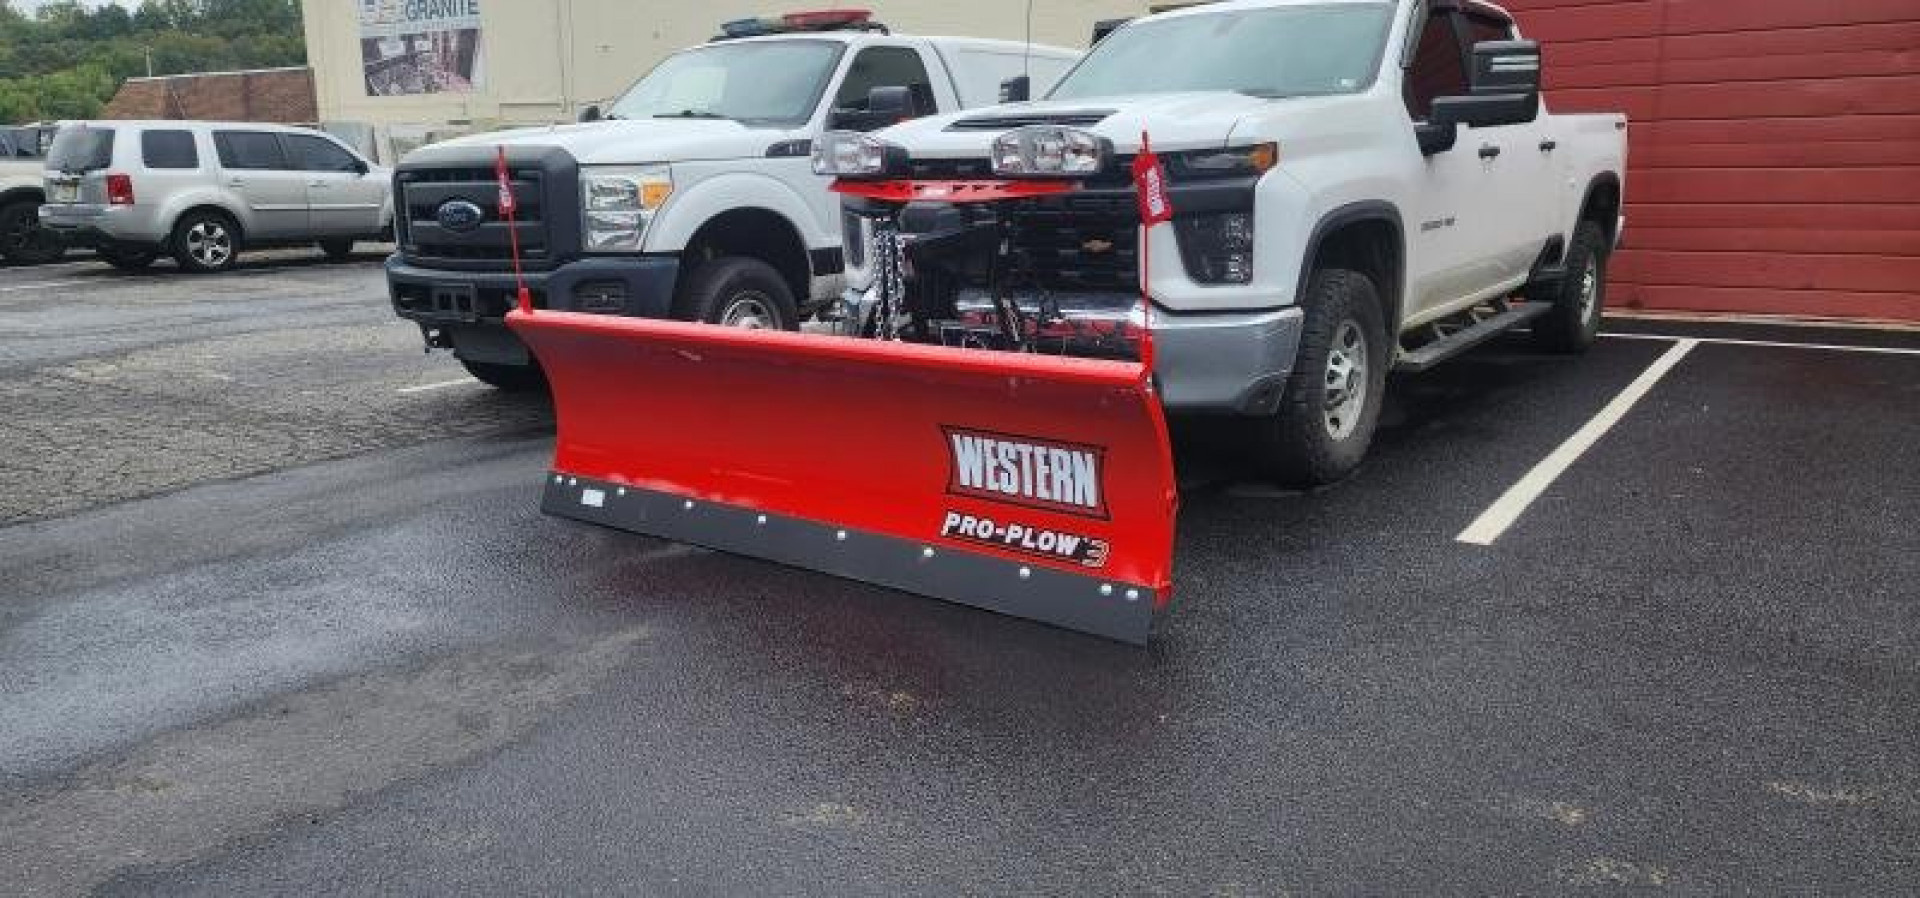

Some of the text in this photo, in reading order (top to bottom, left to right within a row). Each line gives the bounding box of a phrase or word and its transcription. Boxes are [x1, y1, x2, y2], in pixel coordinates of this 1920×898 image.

[405, 0, 480, 19] GRANITE
[952, 434, 1096, 507] WESTERN
[941, 511, 1081, 556] PRO-PLOW
